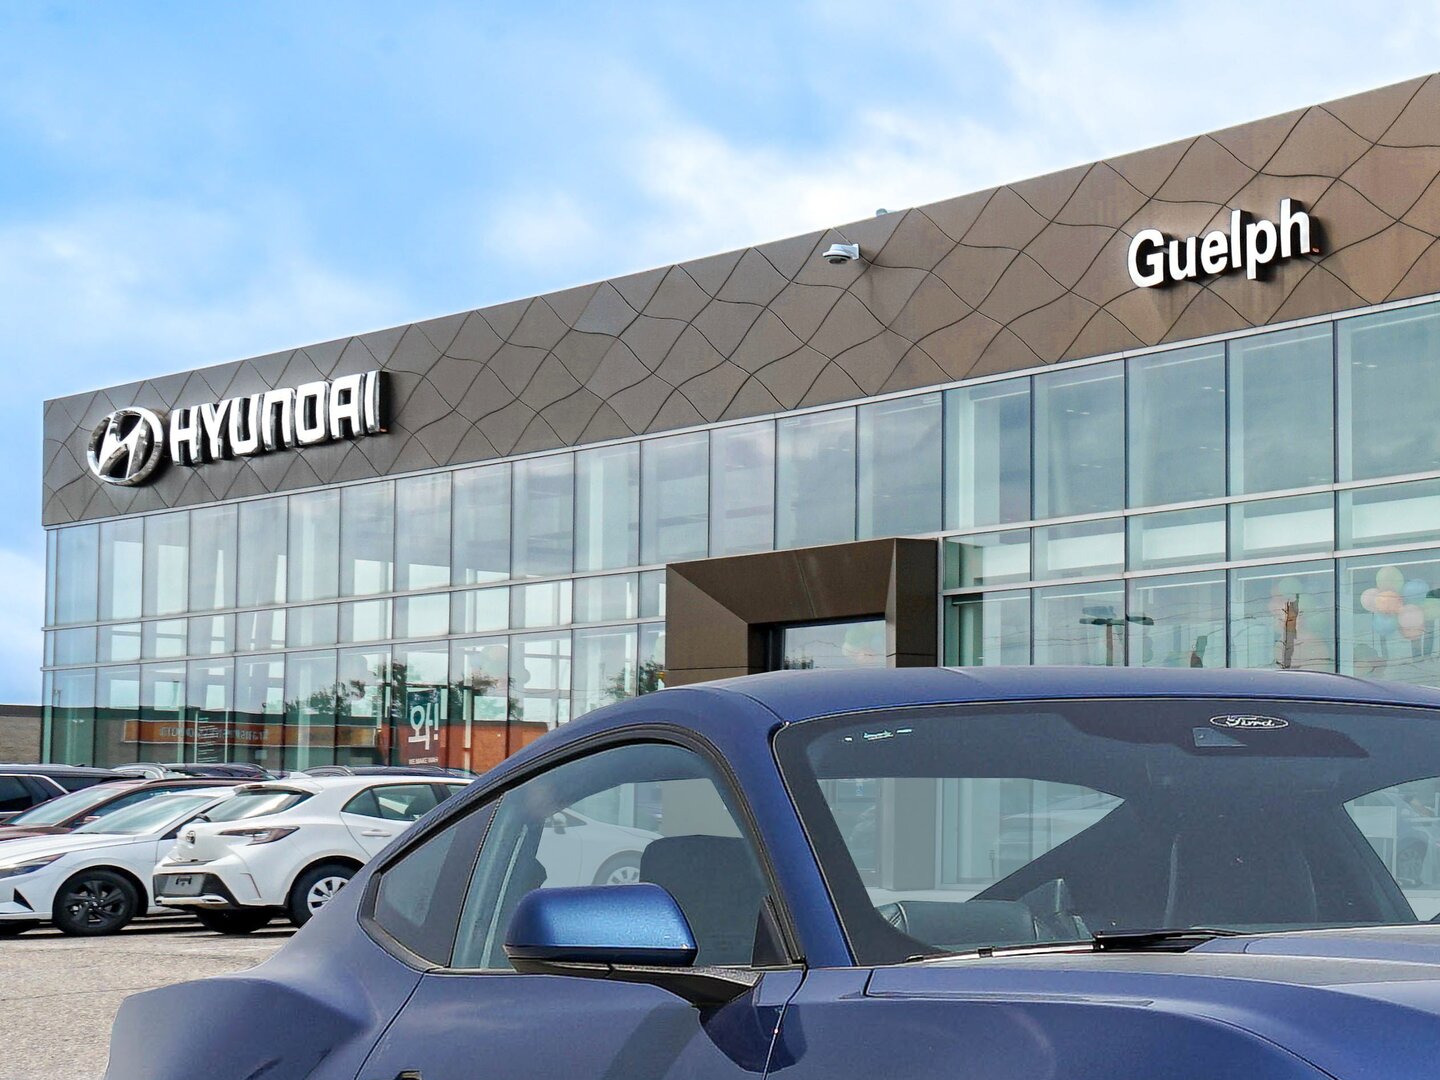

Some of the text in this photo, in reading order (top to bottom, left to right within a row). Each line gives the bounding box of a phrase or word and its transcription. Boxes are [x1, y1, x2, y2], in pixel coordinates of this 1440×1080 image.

[1127, 197, 1313, 288] Guelph
[169, 369, 382, 464] HYUNDAI
[1225, 714, 1276, 727] Ford
